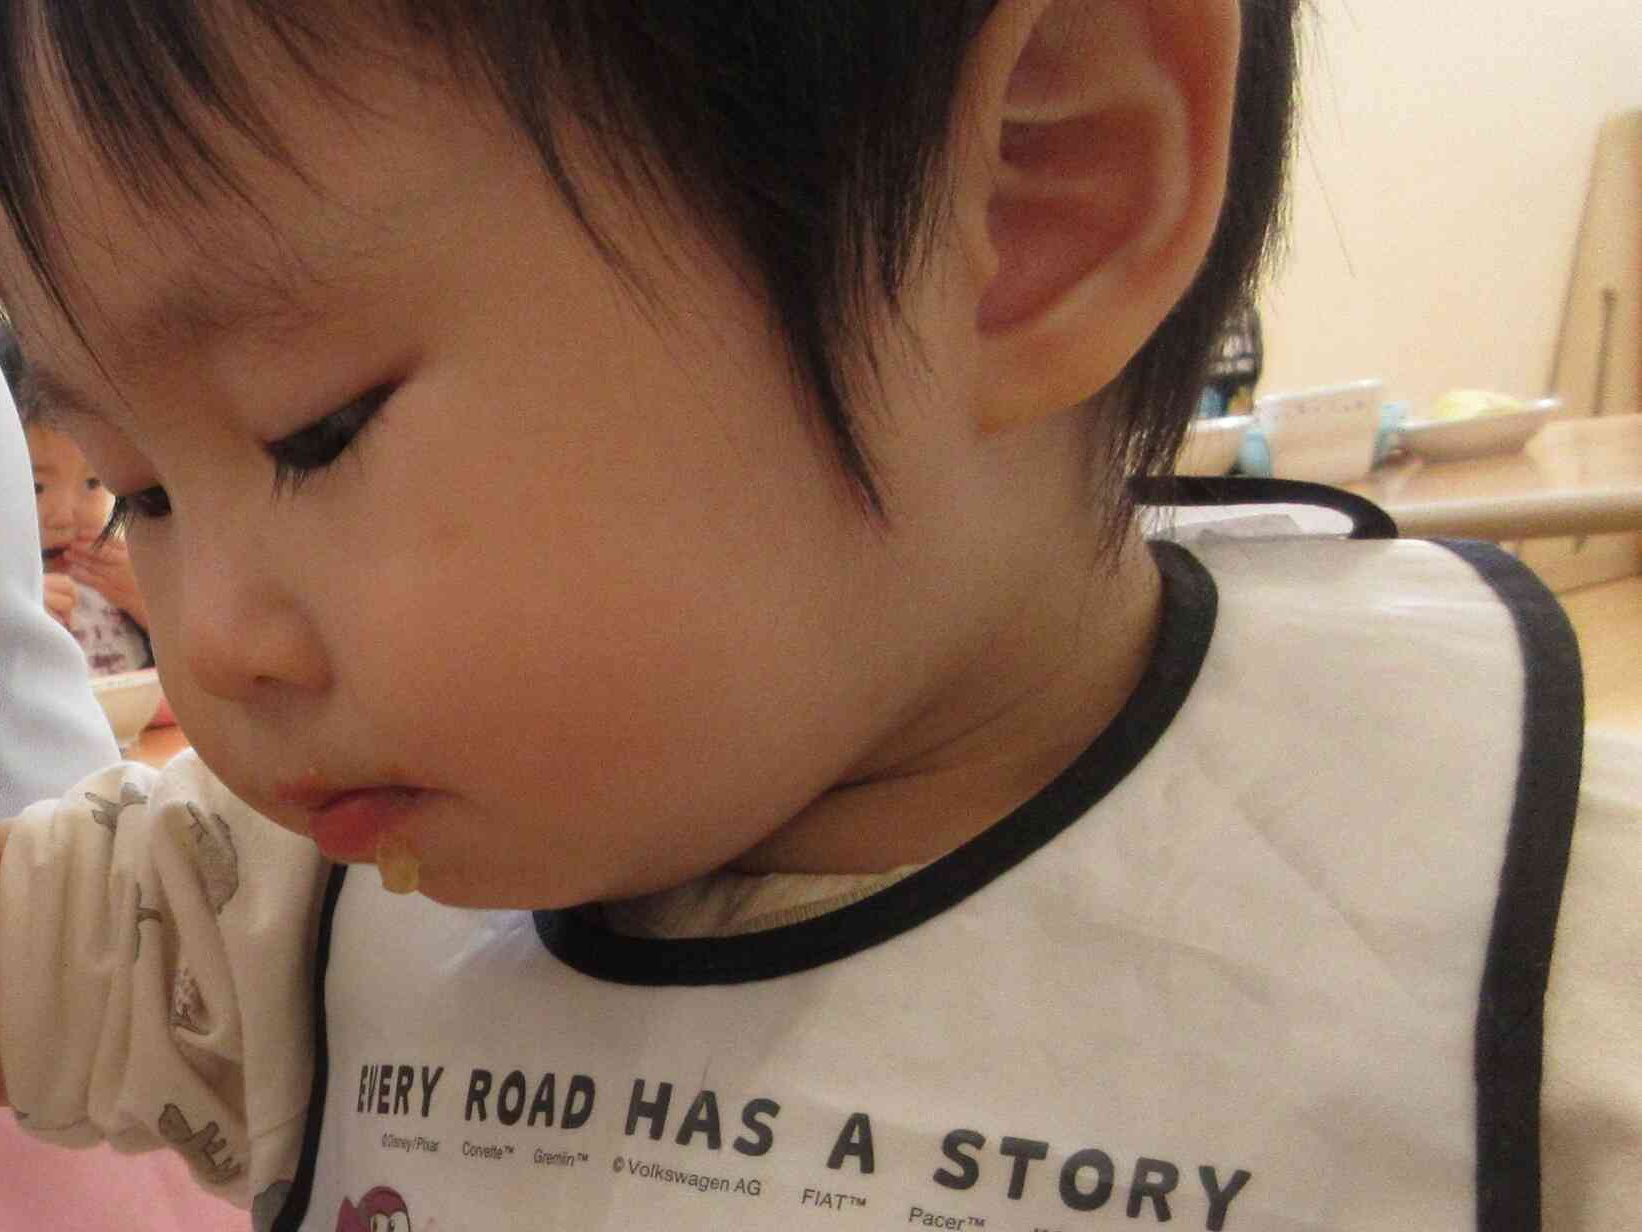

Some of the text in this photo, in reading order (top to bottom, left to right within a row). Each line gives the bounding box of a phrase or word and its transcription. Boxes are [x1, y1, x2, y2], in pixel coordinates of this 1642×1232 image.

[356, 1064, 1253, 1232] EVERY ROAD HAS A STORY
[627, 1158, 730, 1193] Volkswagen
[733, 1178, 762, 1197] AG
